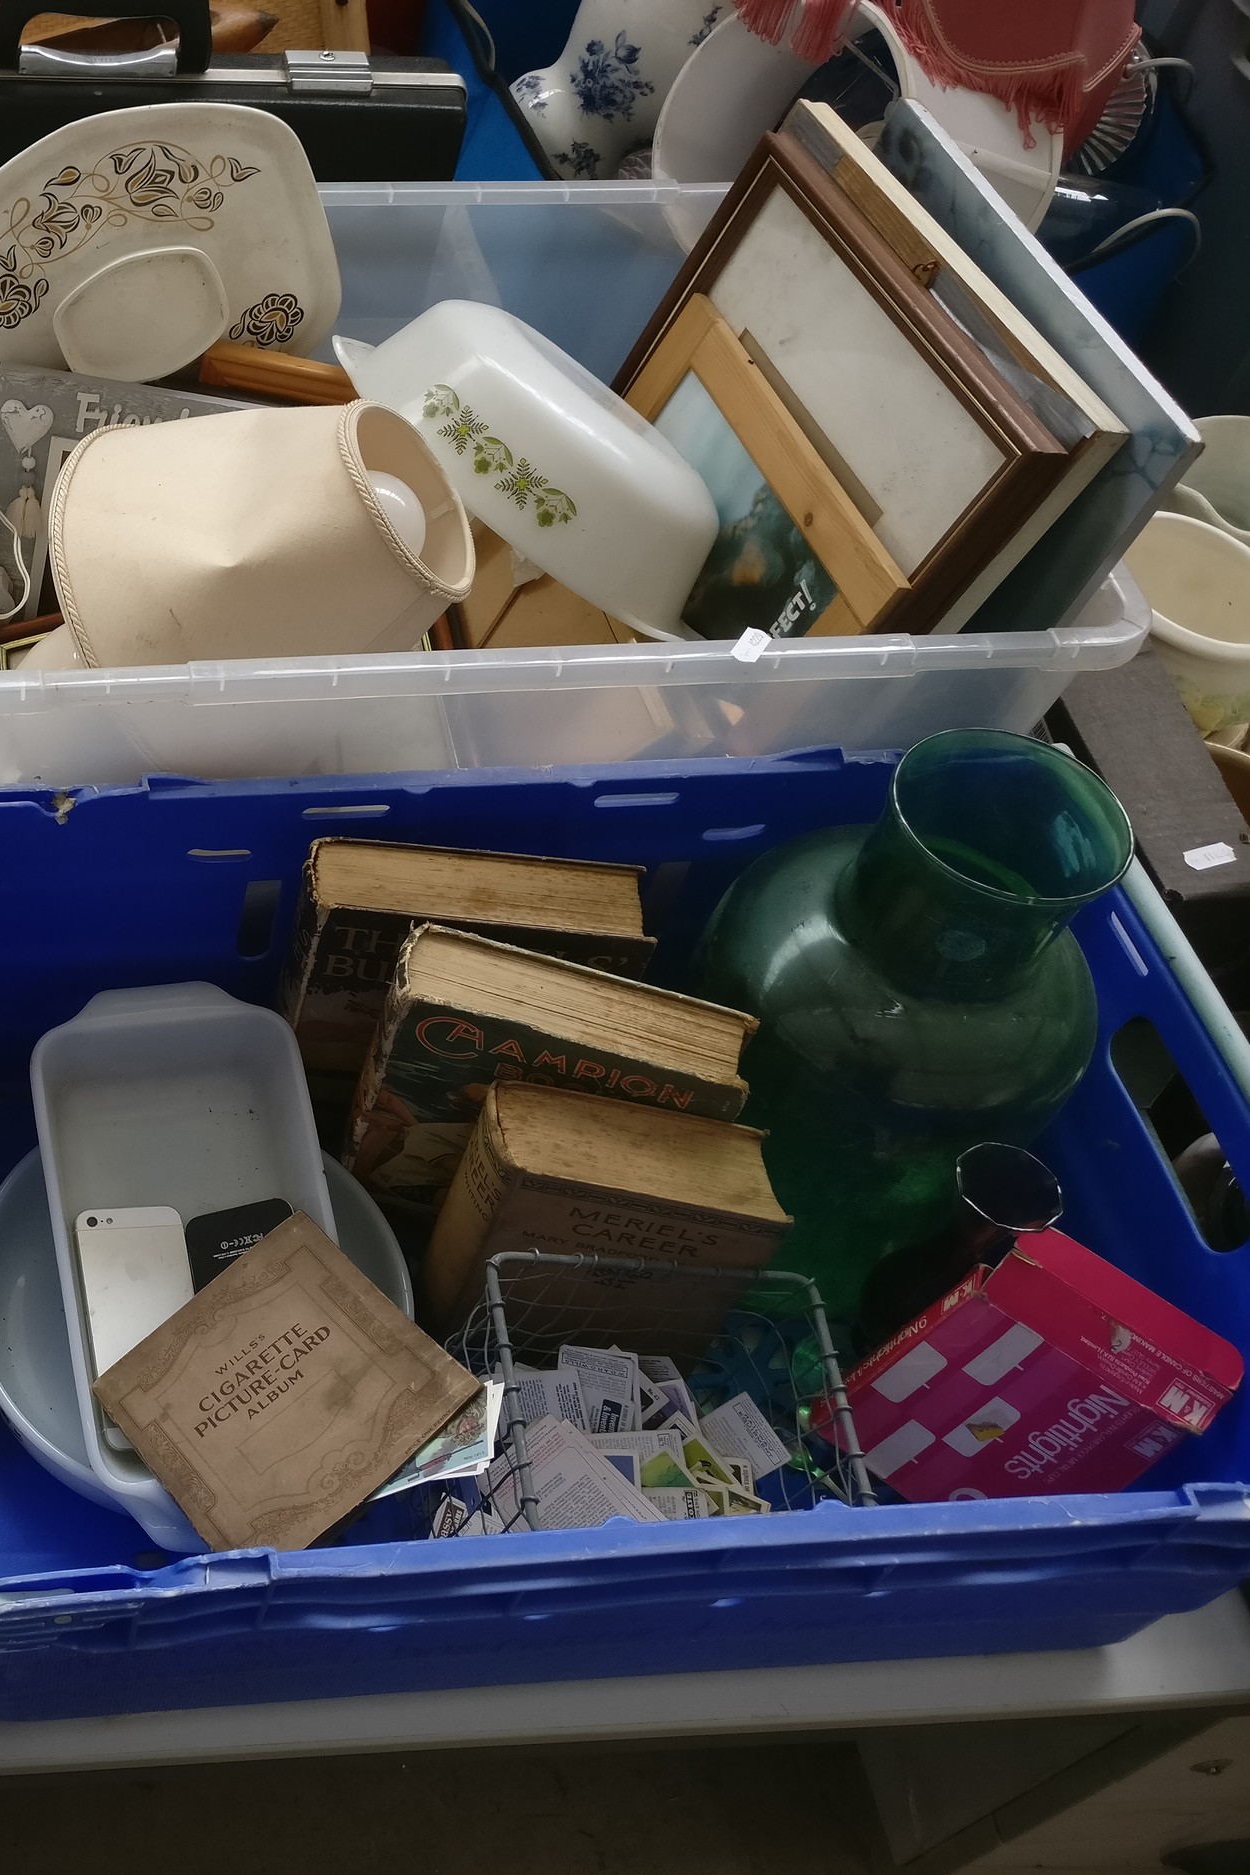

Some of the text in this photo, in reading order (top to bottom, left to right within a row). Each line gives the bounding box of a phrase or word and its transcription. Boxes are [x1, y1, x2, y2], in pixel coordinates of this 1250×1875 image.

[522, 1229, 569, 1246] MARY
[568, 1206, 721, 1247] MERIEL'S
[571, 1223, 699, 1259] CAREER
[198, 1322, 309, 1413] CIGARETTE
[1156, 1349, 1183, 1372] CANDLE
[1181, 1367, 1193, 1378] OF
[193, 1325, 332, 1438] PICTURE-CARD
[246, 1368, 305, 1420] ALBUM
[1192, 1374, 1225, 1400] MASTERS
[404, 1438, 421, 1455] PRICE
[421, 1427, 433, 1442] ONE
[1004, 1385, 1131, 1479] Nightlights
